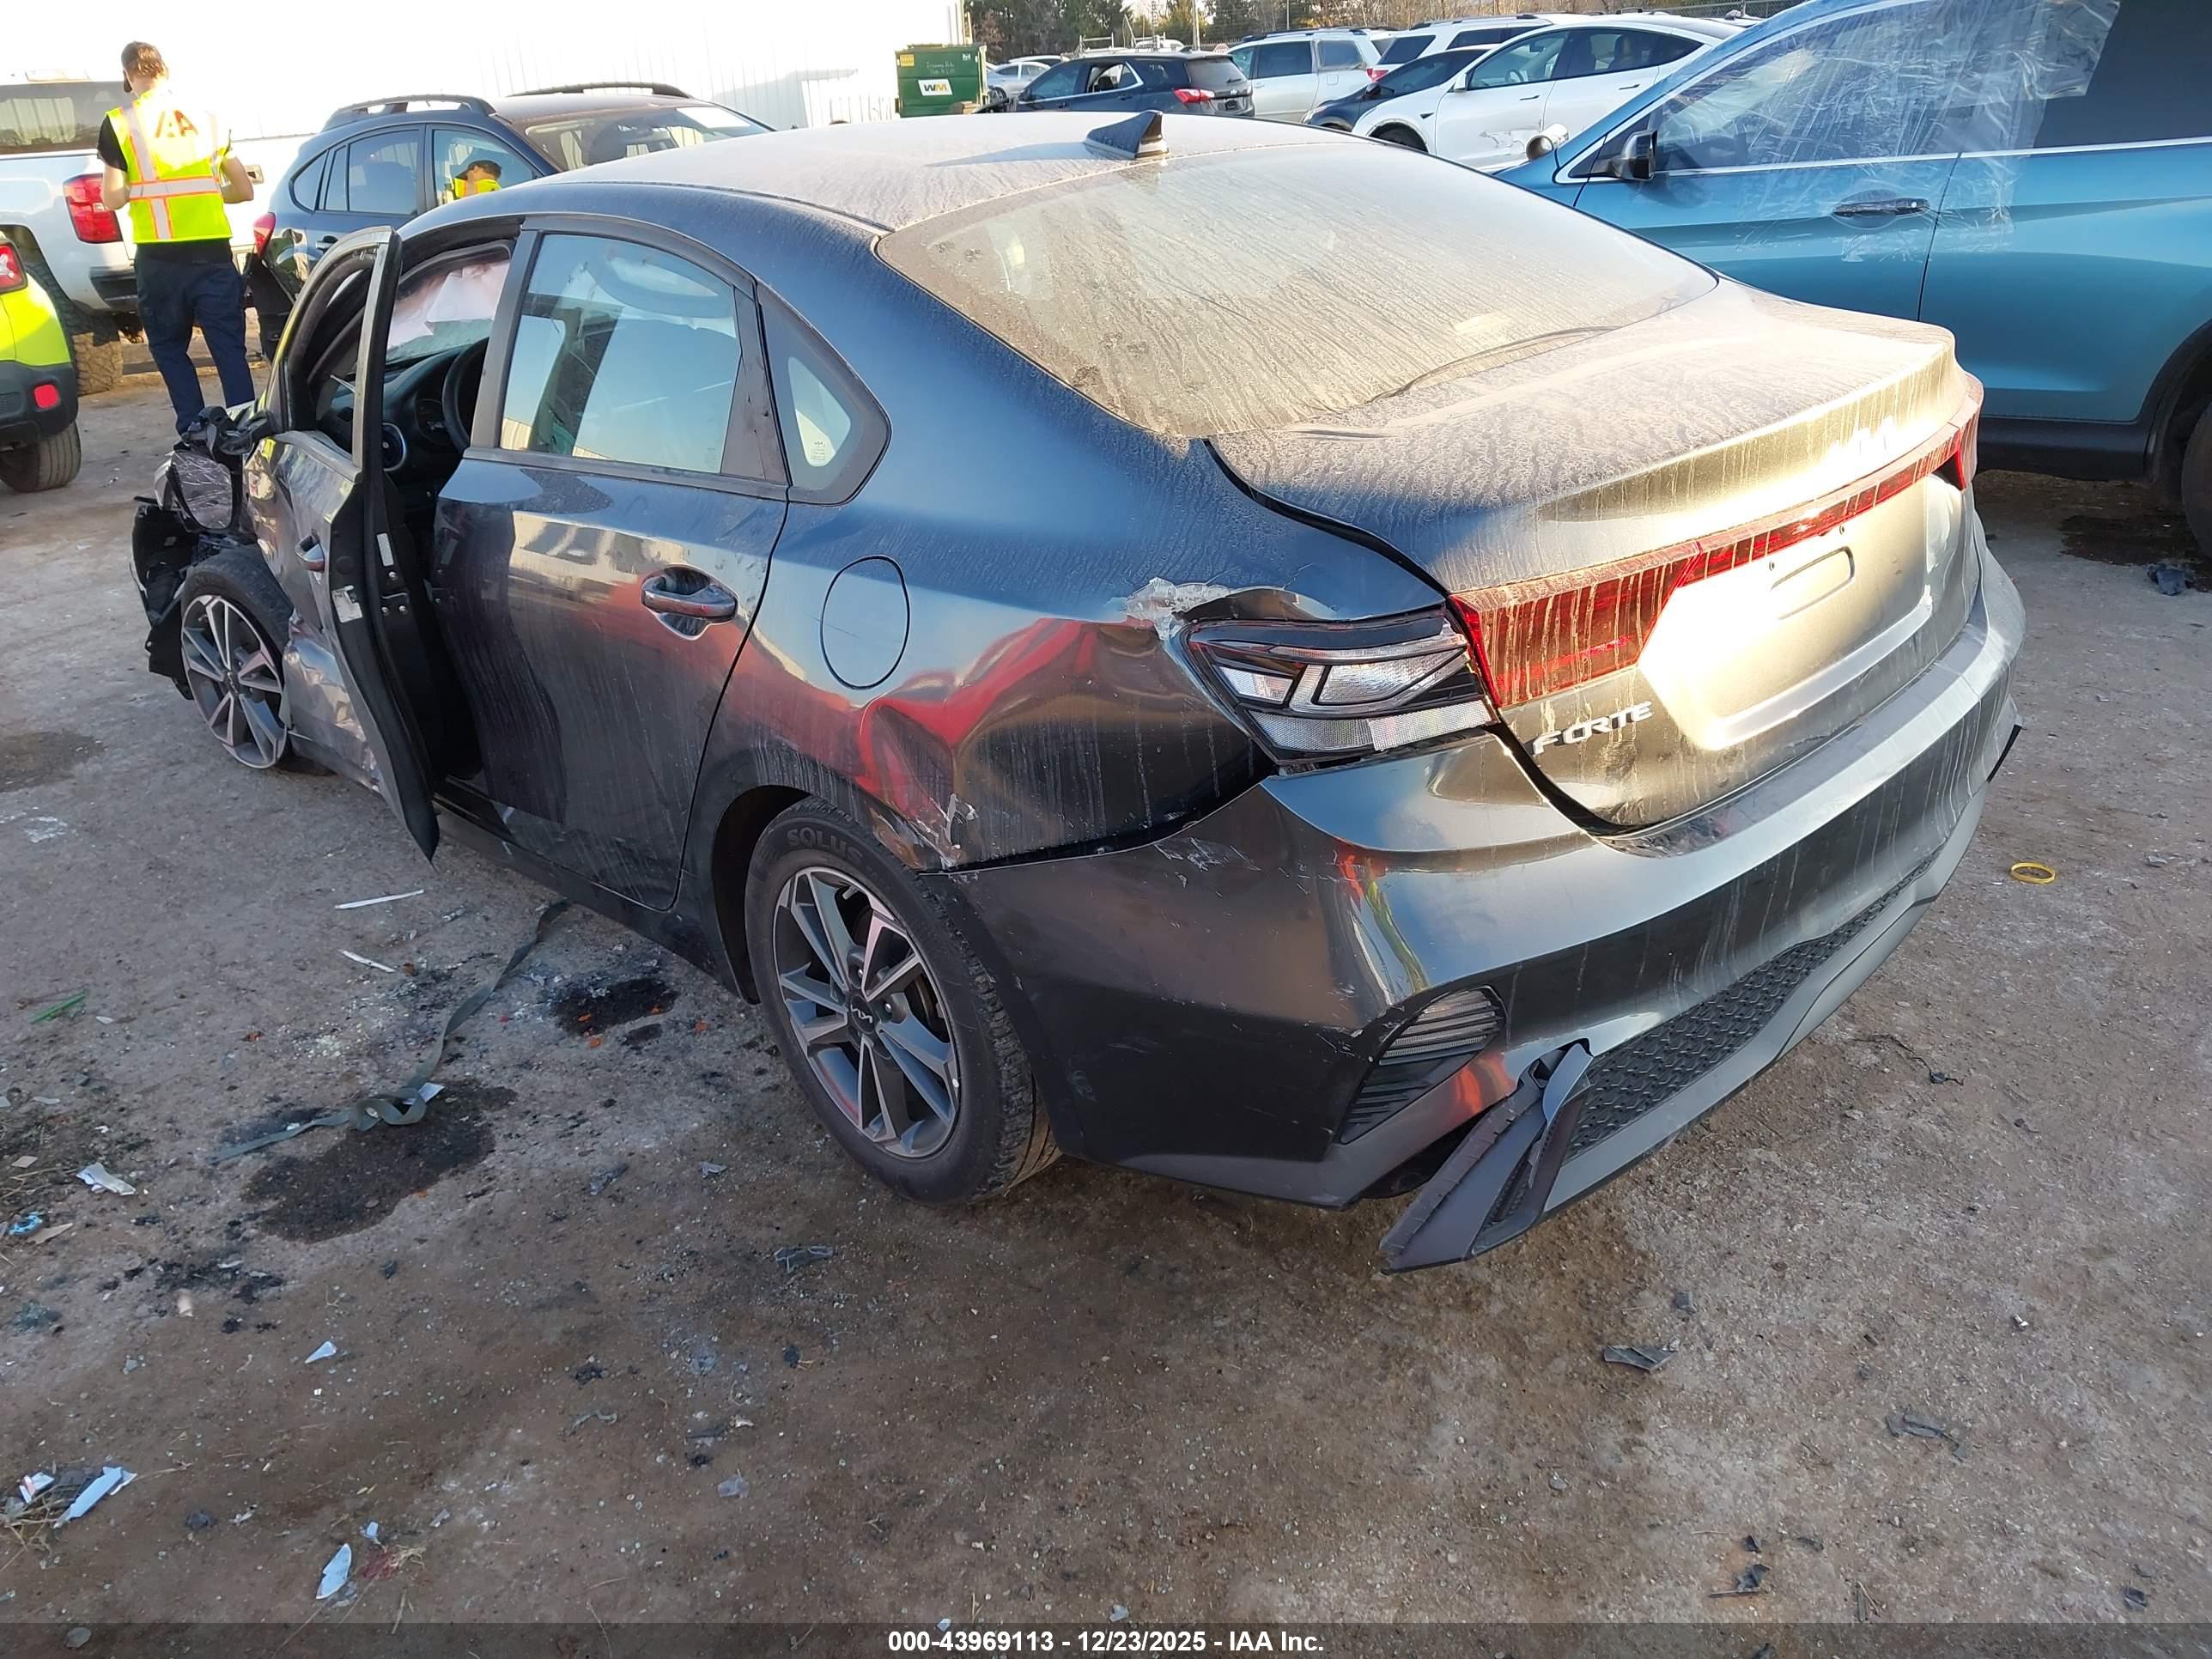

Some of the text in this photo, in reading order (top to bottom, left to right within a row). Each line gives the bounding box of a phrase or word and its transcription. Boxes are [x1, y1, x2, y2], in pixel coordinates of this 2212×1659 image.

[923, 83, 947, 92] WM
[1533, 701, 1654, 755] FORTE
[787, 827, 863, 864] SOLUS
